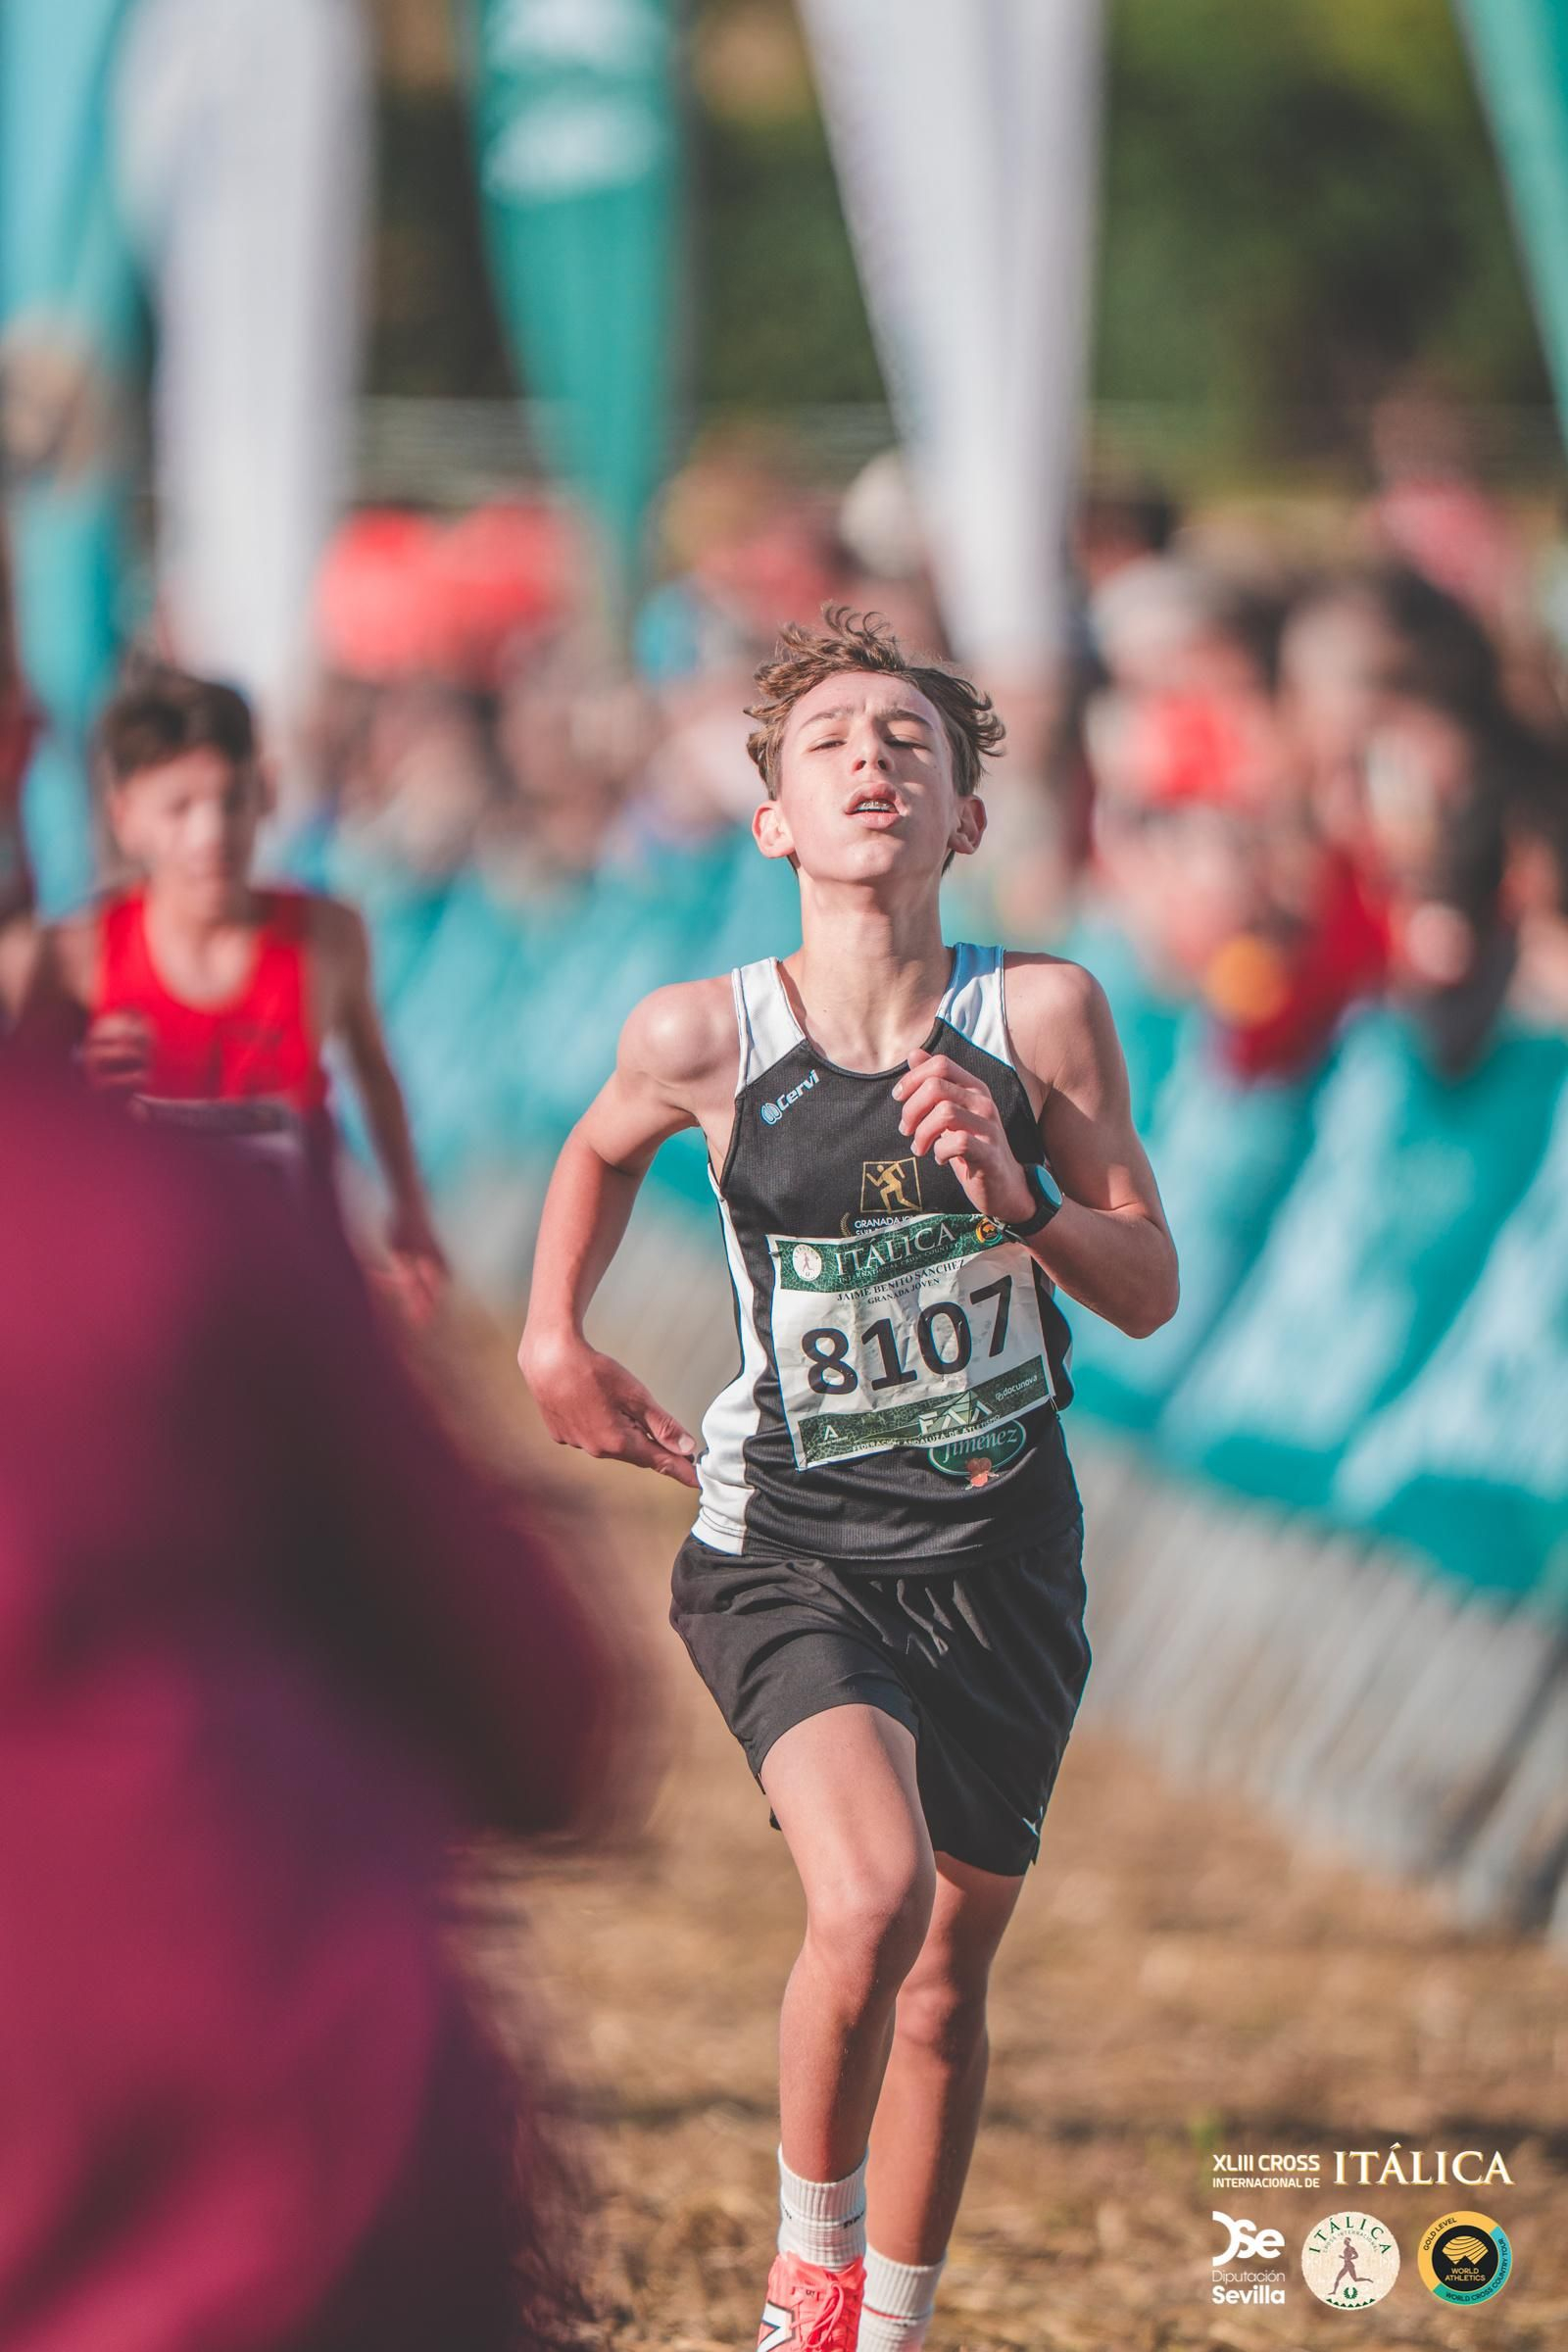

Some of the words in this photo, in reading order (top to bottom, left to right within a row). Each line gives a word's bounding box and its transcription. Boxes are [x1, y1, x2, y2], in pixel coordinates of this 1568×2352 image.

[775, 1069, 820, 1111] Cervi
[855, 1216, 901, 1229] GRANADA
[835, 1222, 956, 1276] ITÁLICA
[837, 1286, 872, 1301] JAIME
[873, 1274, 913, 1294] BENITO
[867, 1288, 910, 1304] GRANADA
[911, 1277, 940, 1292] JOVEN
[801, 1274, 1012, 1396] 8107
[1003, 1374, 1038, 1396] docunova
[903, 1432, 947, 1446] ANDALUZA
[948, 1429, 959, 1439] DE
[962, 1414, 1001, 1434] ATLETISMO
